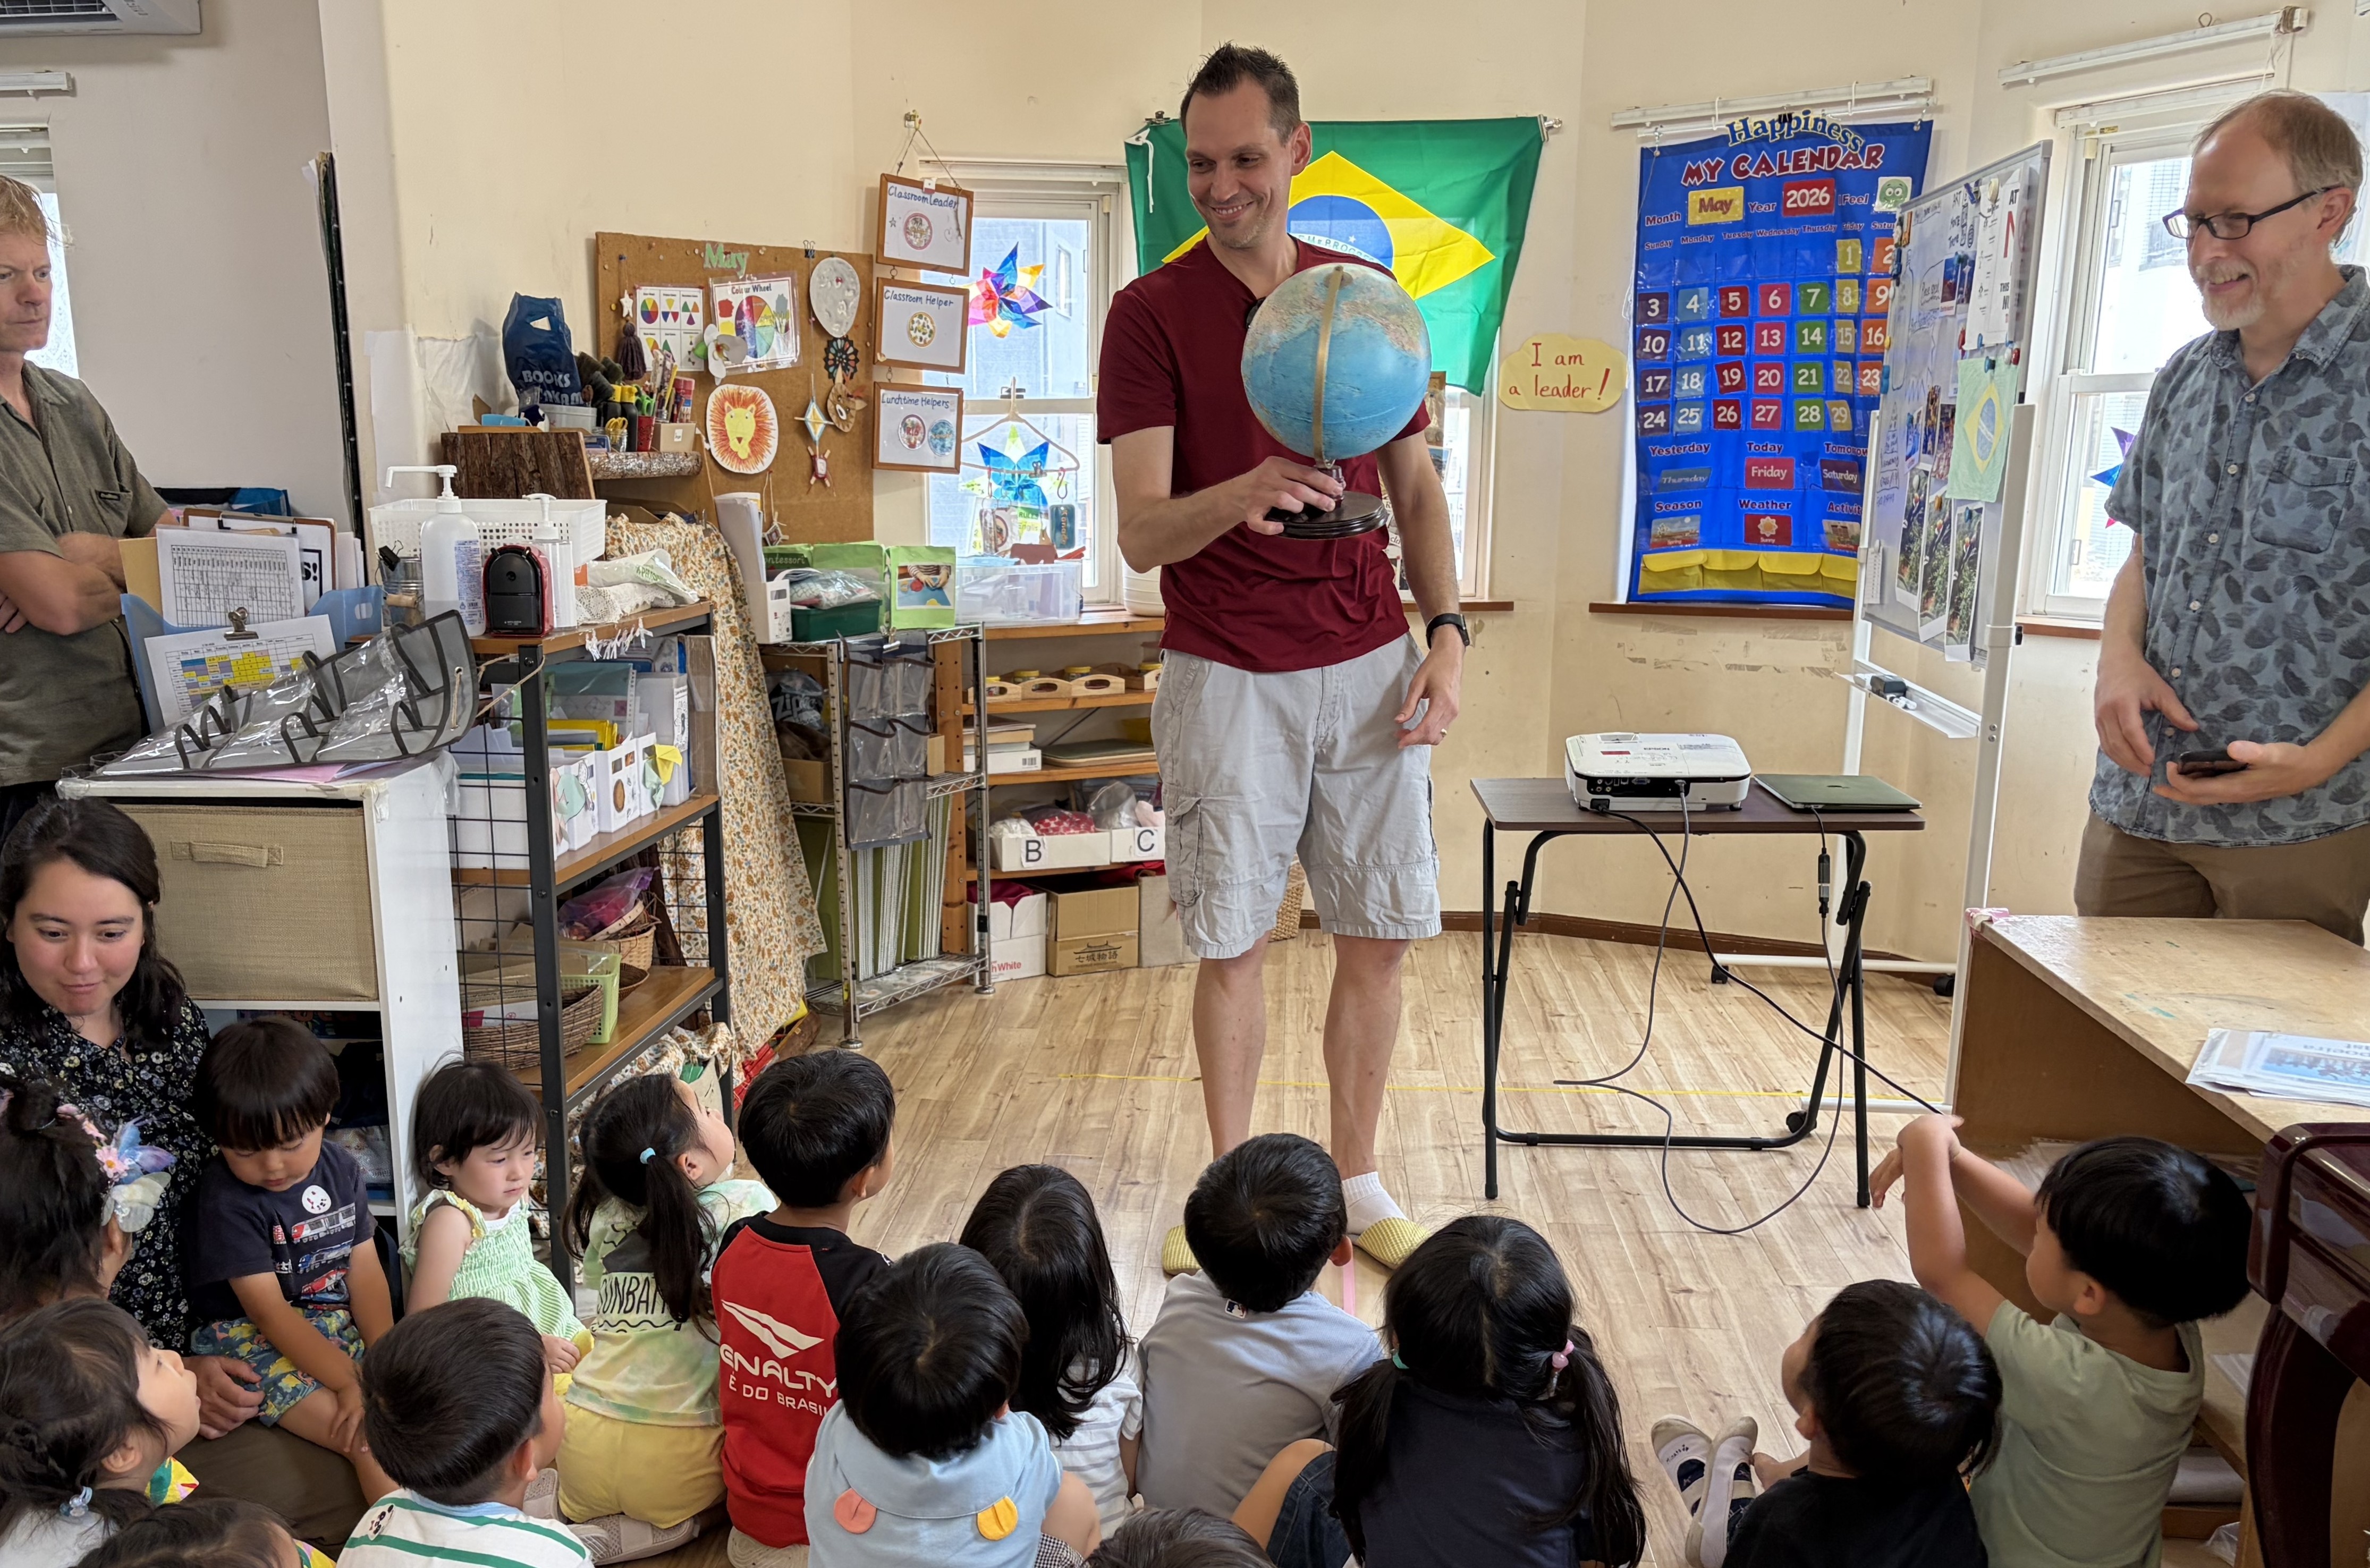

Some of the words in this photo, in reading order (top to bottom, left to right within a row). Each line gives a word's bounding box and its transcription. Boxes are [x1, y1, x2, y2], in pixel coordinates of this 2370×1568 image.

[1726, 109, 1866, 153] Happiness
[1681, 157, 1724, 187] MY
[1731, 143, 1885, 179] CALENDAR
[888, 185, 929, 204] Classroom
[930, 194, 958, 209] Leader
[1748, 201, 1777, 213] Year
[1786, 187, 1830, 208] 2026
[1842, 193, 1868, 205] Feel
[1645, 211, 1681, 226] Month
[1698, 197, 1734, 215] May
[1645, 240, 1673, 250] Sunday
[1681, 235, 1714, 244] Monday
[1722, 231, 1754, 240] Tuesday
[1756, 227, 1800, 237] Wednesday
[1802, 224, 1837, 234] Thursday
[704, 243, 750, 279] May
[1846, 246, 1852, 265] 1
[1883, 245, 1893, 264] 2
[752, 283, 772, 293] Wheel
[884, 290, 922, 304] Classroom
[926, 295, 954, 310] Helper
[1647, 299, 1660, 317] 3
[1686, 294, 1699, 313] 4
[1728, 292, 1741, 310] 5
[1768, 290, 1781, 309] 6
[1807, 289, 1821, 307] 7
[1843, 287, 1852, 306] 8
[1876, 286, 1889, 306] 9
[1643, 336, 1665, 353] 10
[1688, 334, 1705, 351] 11
[1723, 332, 1742, 348] 12
[1761, 329, 1781, 346] 13
[1802, 327, 1822, 345] 14
[1839, 327, 1852, 344] 15
[1866, 327, 1884, 345] 16
[1531, 343, 1542, 367] I
[1555, 354, 1585, 366] am
[522, 370, 571, 387] BOOKS
[1509, 386, 1521, 395] a
[1645, 376, 1667, 393] 17
[1682, 372, 1700, 389] 18
[1722, 368, 1741, 386] 19
[1758, 369, 1781, 386] 20
[1798, 368, 1818, 385] 21
[1836, 368, 1851, 385] 22
[1863, 369, 1881, 386] 23
[882, 393, 919, 405] Lunchtime
[921, 397, 950, 410] Helpers
[1644, 411, 1666, 428] 24
[1678, 408, 1700, 424] 25
[1717, 406, 1738, 422] 26
[1755, 405, 1778, 422] 27
[1799, 405, 1821, 422] 28
[1831, 407, 1848, 423] 29
[1649, 443, 1711, 456] Yesterday
[1747, 442, 1783, 455] Today
[1662, 475, 1707, 484] Thursday
[1751, 465, 1787, 480] Friday
[1823, 469, 1857, 483] Saturday
[1655, 501, 1702, 512] Season
[1739, 499, 1791, 510] Weather
[1827, 502, 1863, 515] Activit
[1026, 840, 1042, 862] B
[1137, 829, 1155, 852] C
[997, 961, 1022, 971] White
[729, 1371, 737, 1392] É
[743, 1384, 768, 1400] DO
